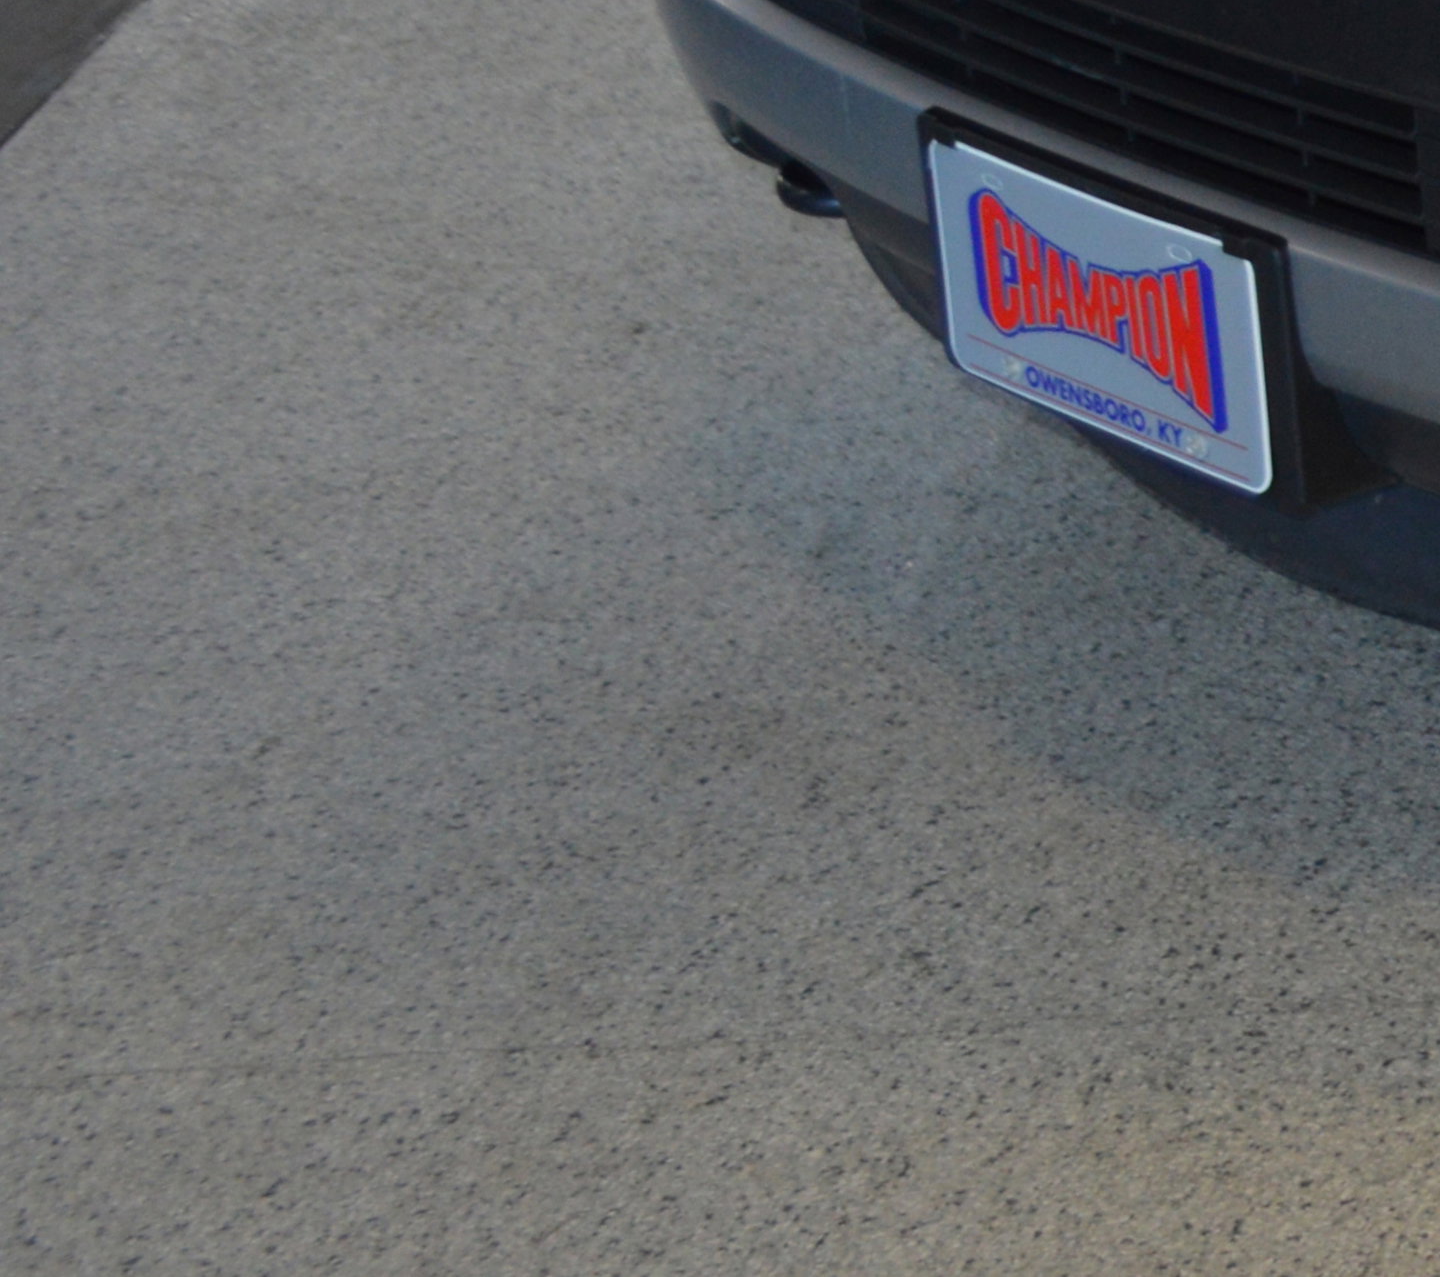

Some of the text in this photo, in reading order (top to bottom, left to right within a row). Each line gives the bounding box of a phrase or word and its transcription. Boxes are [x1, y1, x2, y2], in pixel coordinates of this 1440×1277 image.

[968, 188, 1228, 433] CHAMPION
[1025, 365, 1184, 445] OWENSBORO, KY
